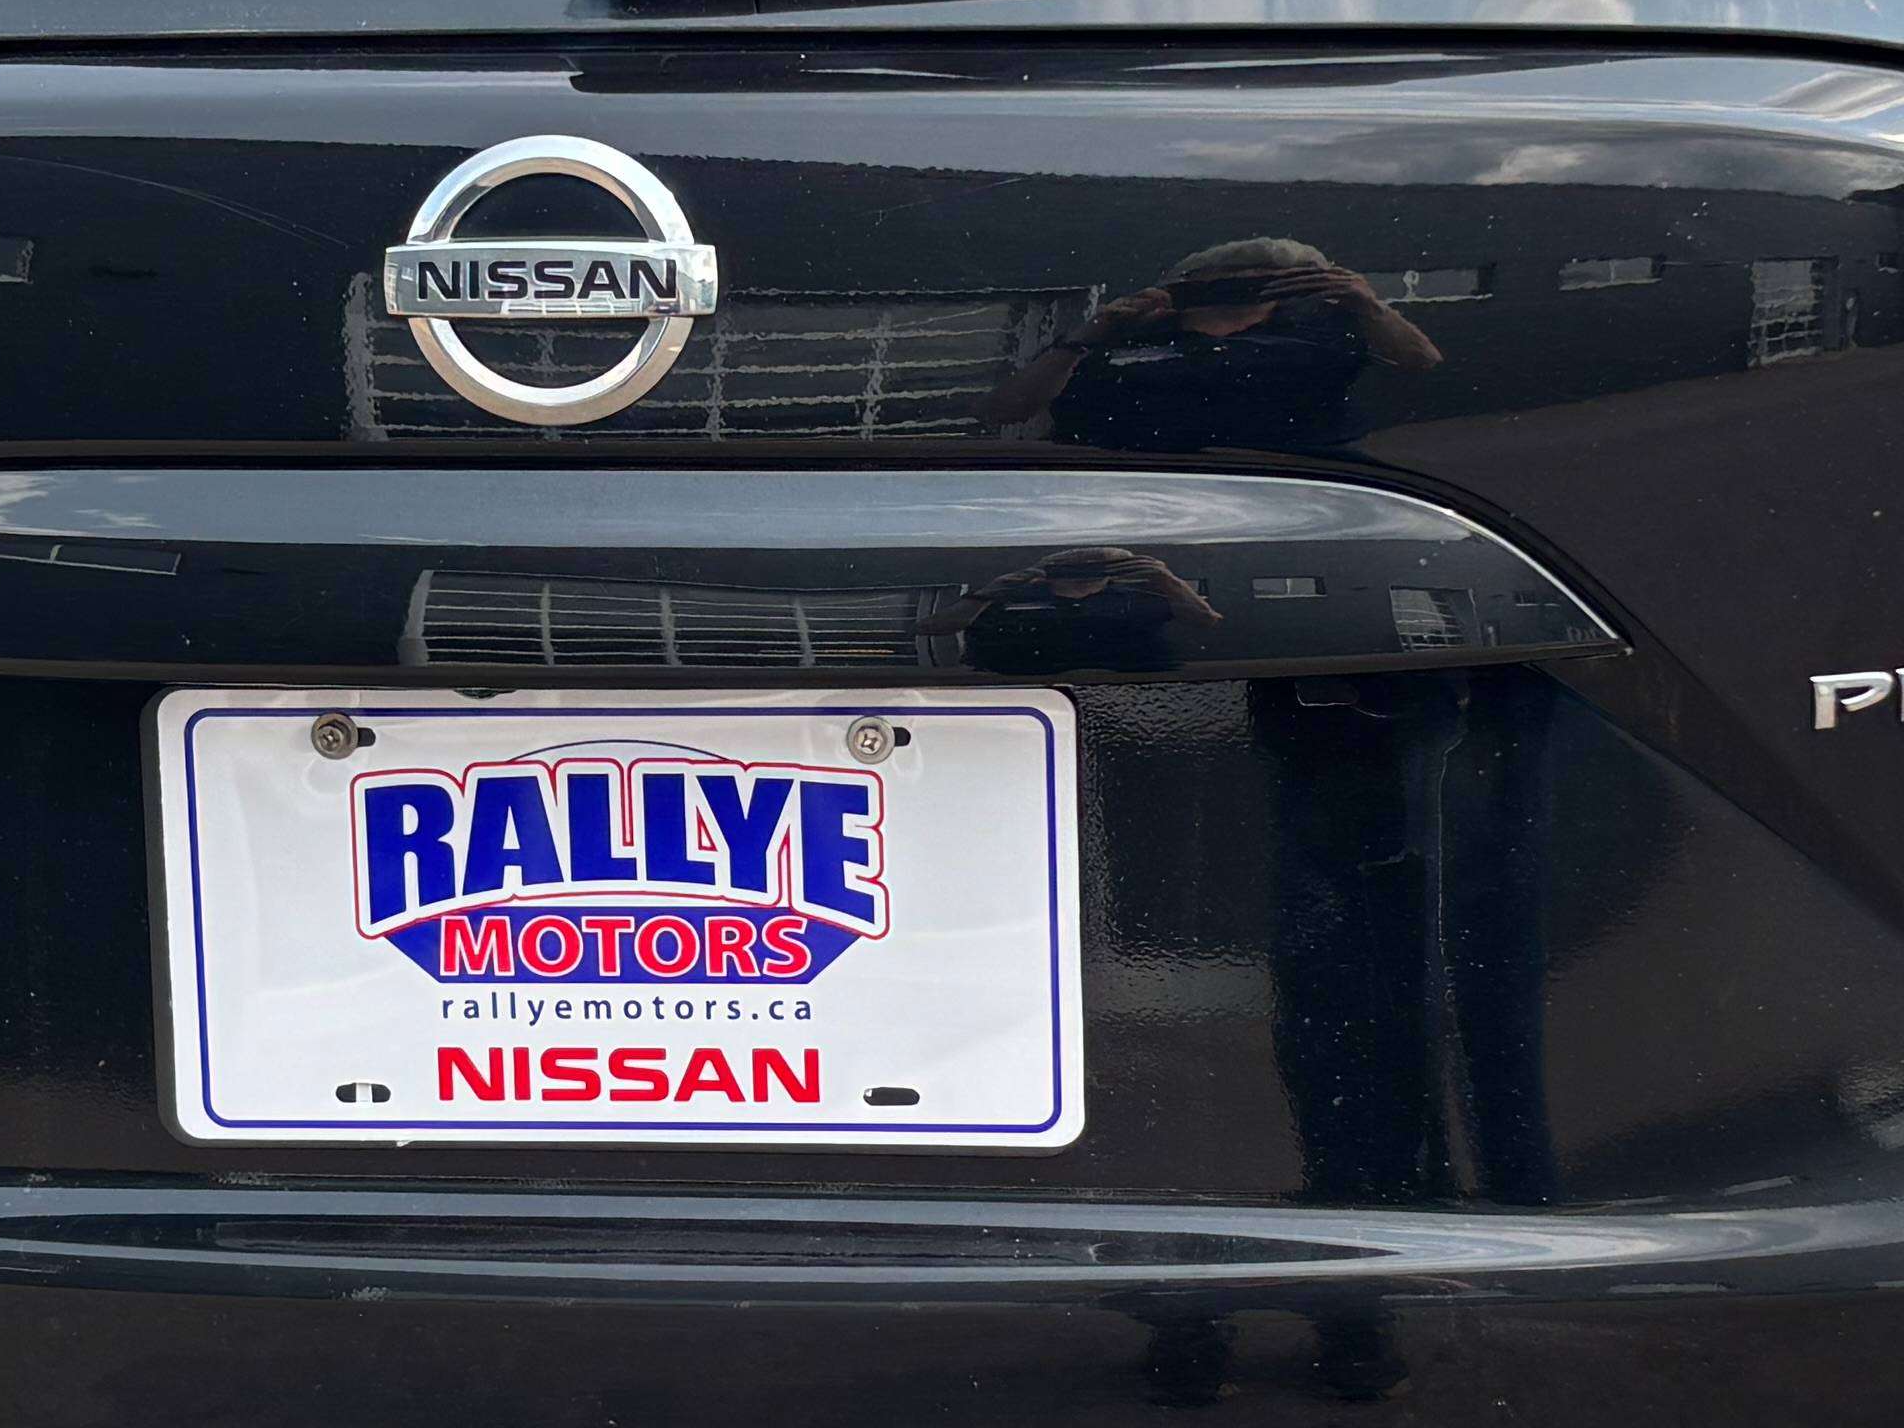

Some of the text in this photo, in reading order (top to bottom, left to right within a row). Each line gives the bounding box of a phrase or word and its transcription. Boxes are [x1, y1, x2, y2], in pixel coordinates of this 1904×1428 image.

[417, 259, 677, 300] NISSAN
[363, 772, 877, 926] RALLYE
[440, 915, 812, 977] MOTORS
[440, 991, 813, 1027] rallyemotors.ca
[437, 1046, 821, 1103] NISSAN
